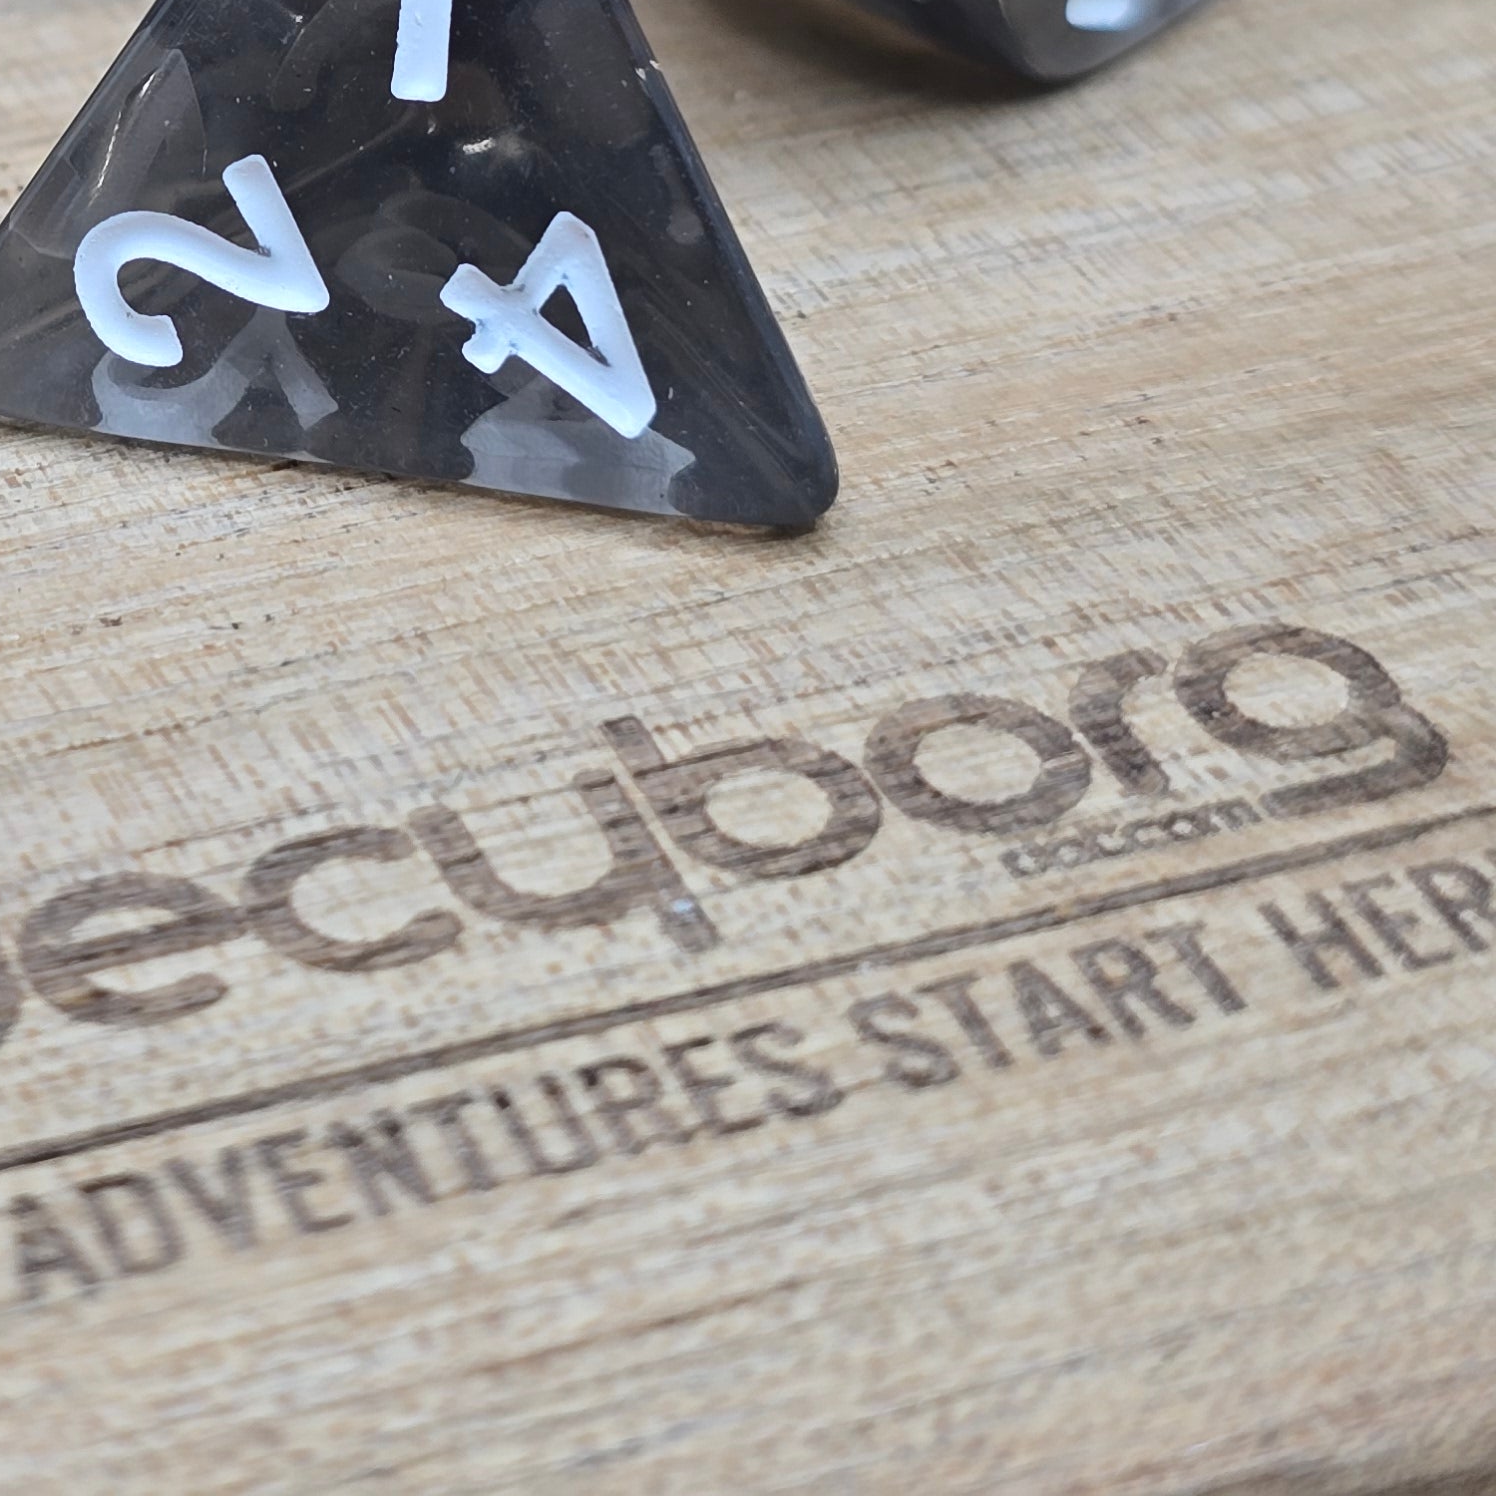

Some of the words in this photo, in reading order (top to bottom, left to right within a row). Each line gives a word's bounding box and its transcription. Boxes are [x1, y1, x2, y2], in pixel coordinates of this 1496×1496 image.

[72, 153, 331, 369] 2
[438, 210, 658, 440] 4
[9, 1022, 846, 1302] ADVENTURES
[847, 919, 1248, 1092] START
[1257, 847, 1496, 990] HER
